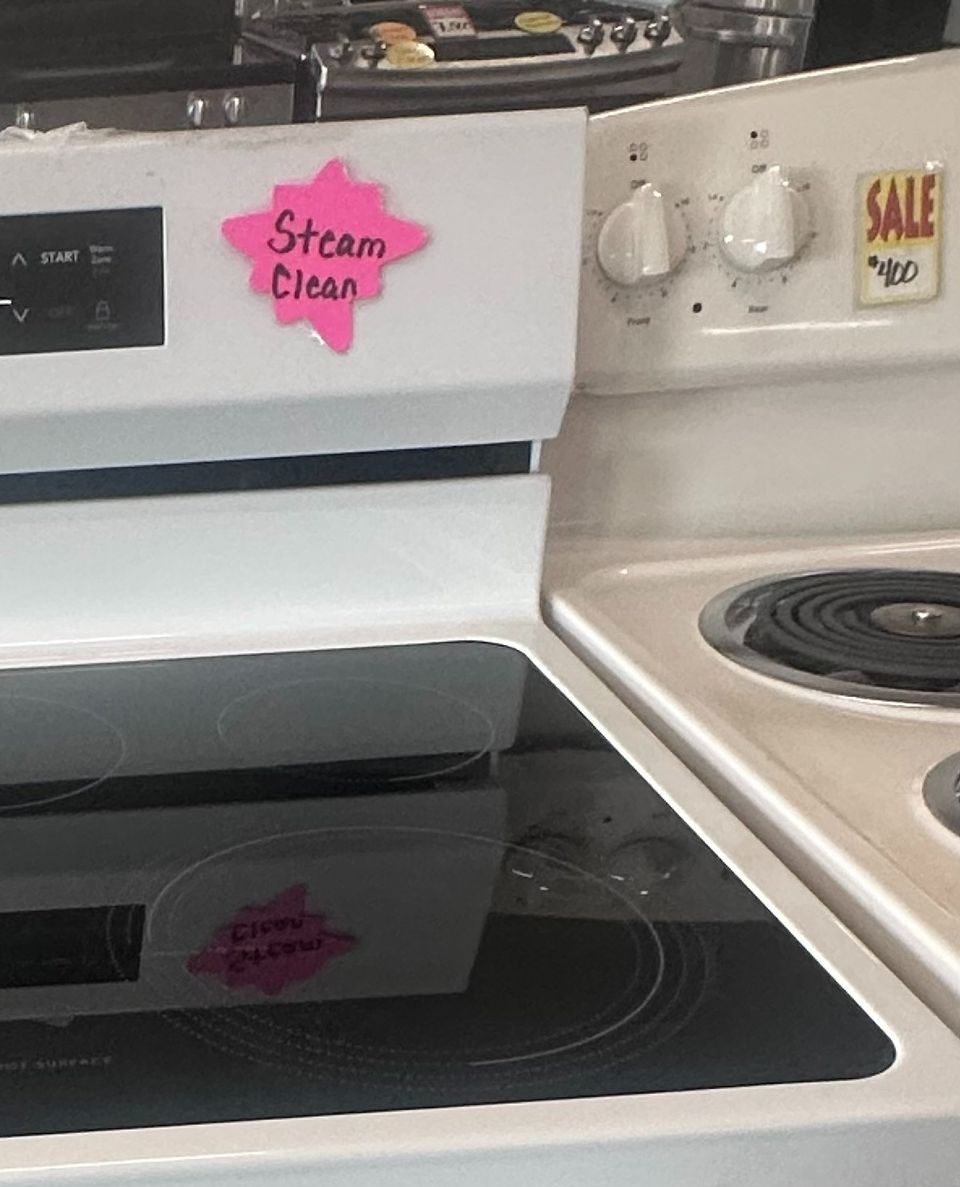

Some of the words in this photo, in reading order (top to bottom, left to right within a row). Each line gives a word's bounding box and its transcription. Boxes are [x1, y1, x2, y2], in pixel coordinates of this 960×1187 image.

[866, 174, 936, 243] SALE
[267, 208, 386, 259] Steam
[40, 250, 80, 265] START
[271, 263, 358, 301] Clean
